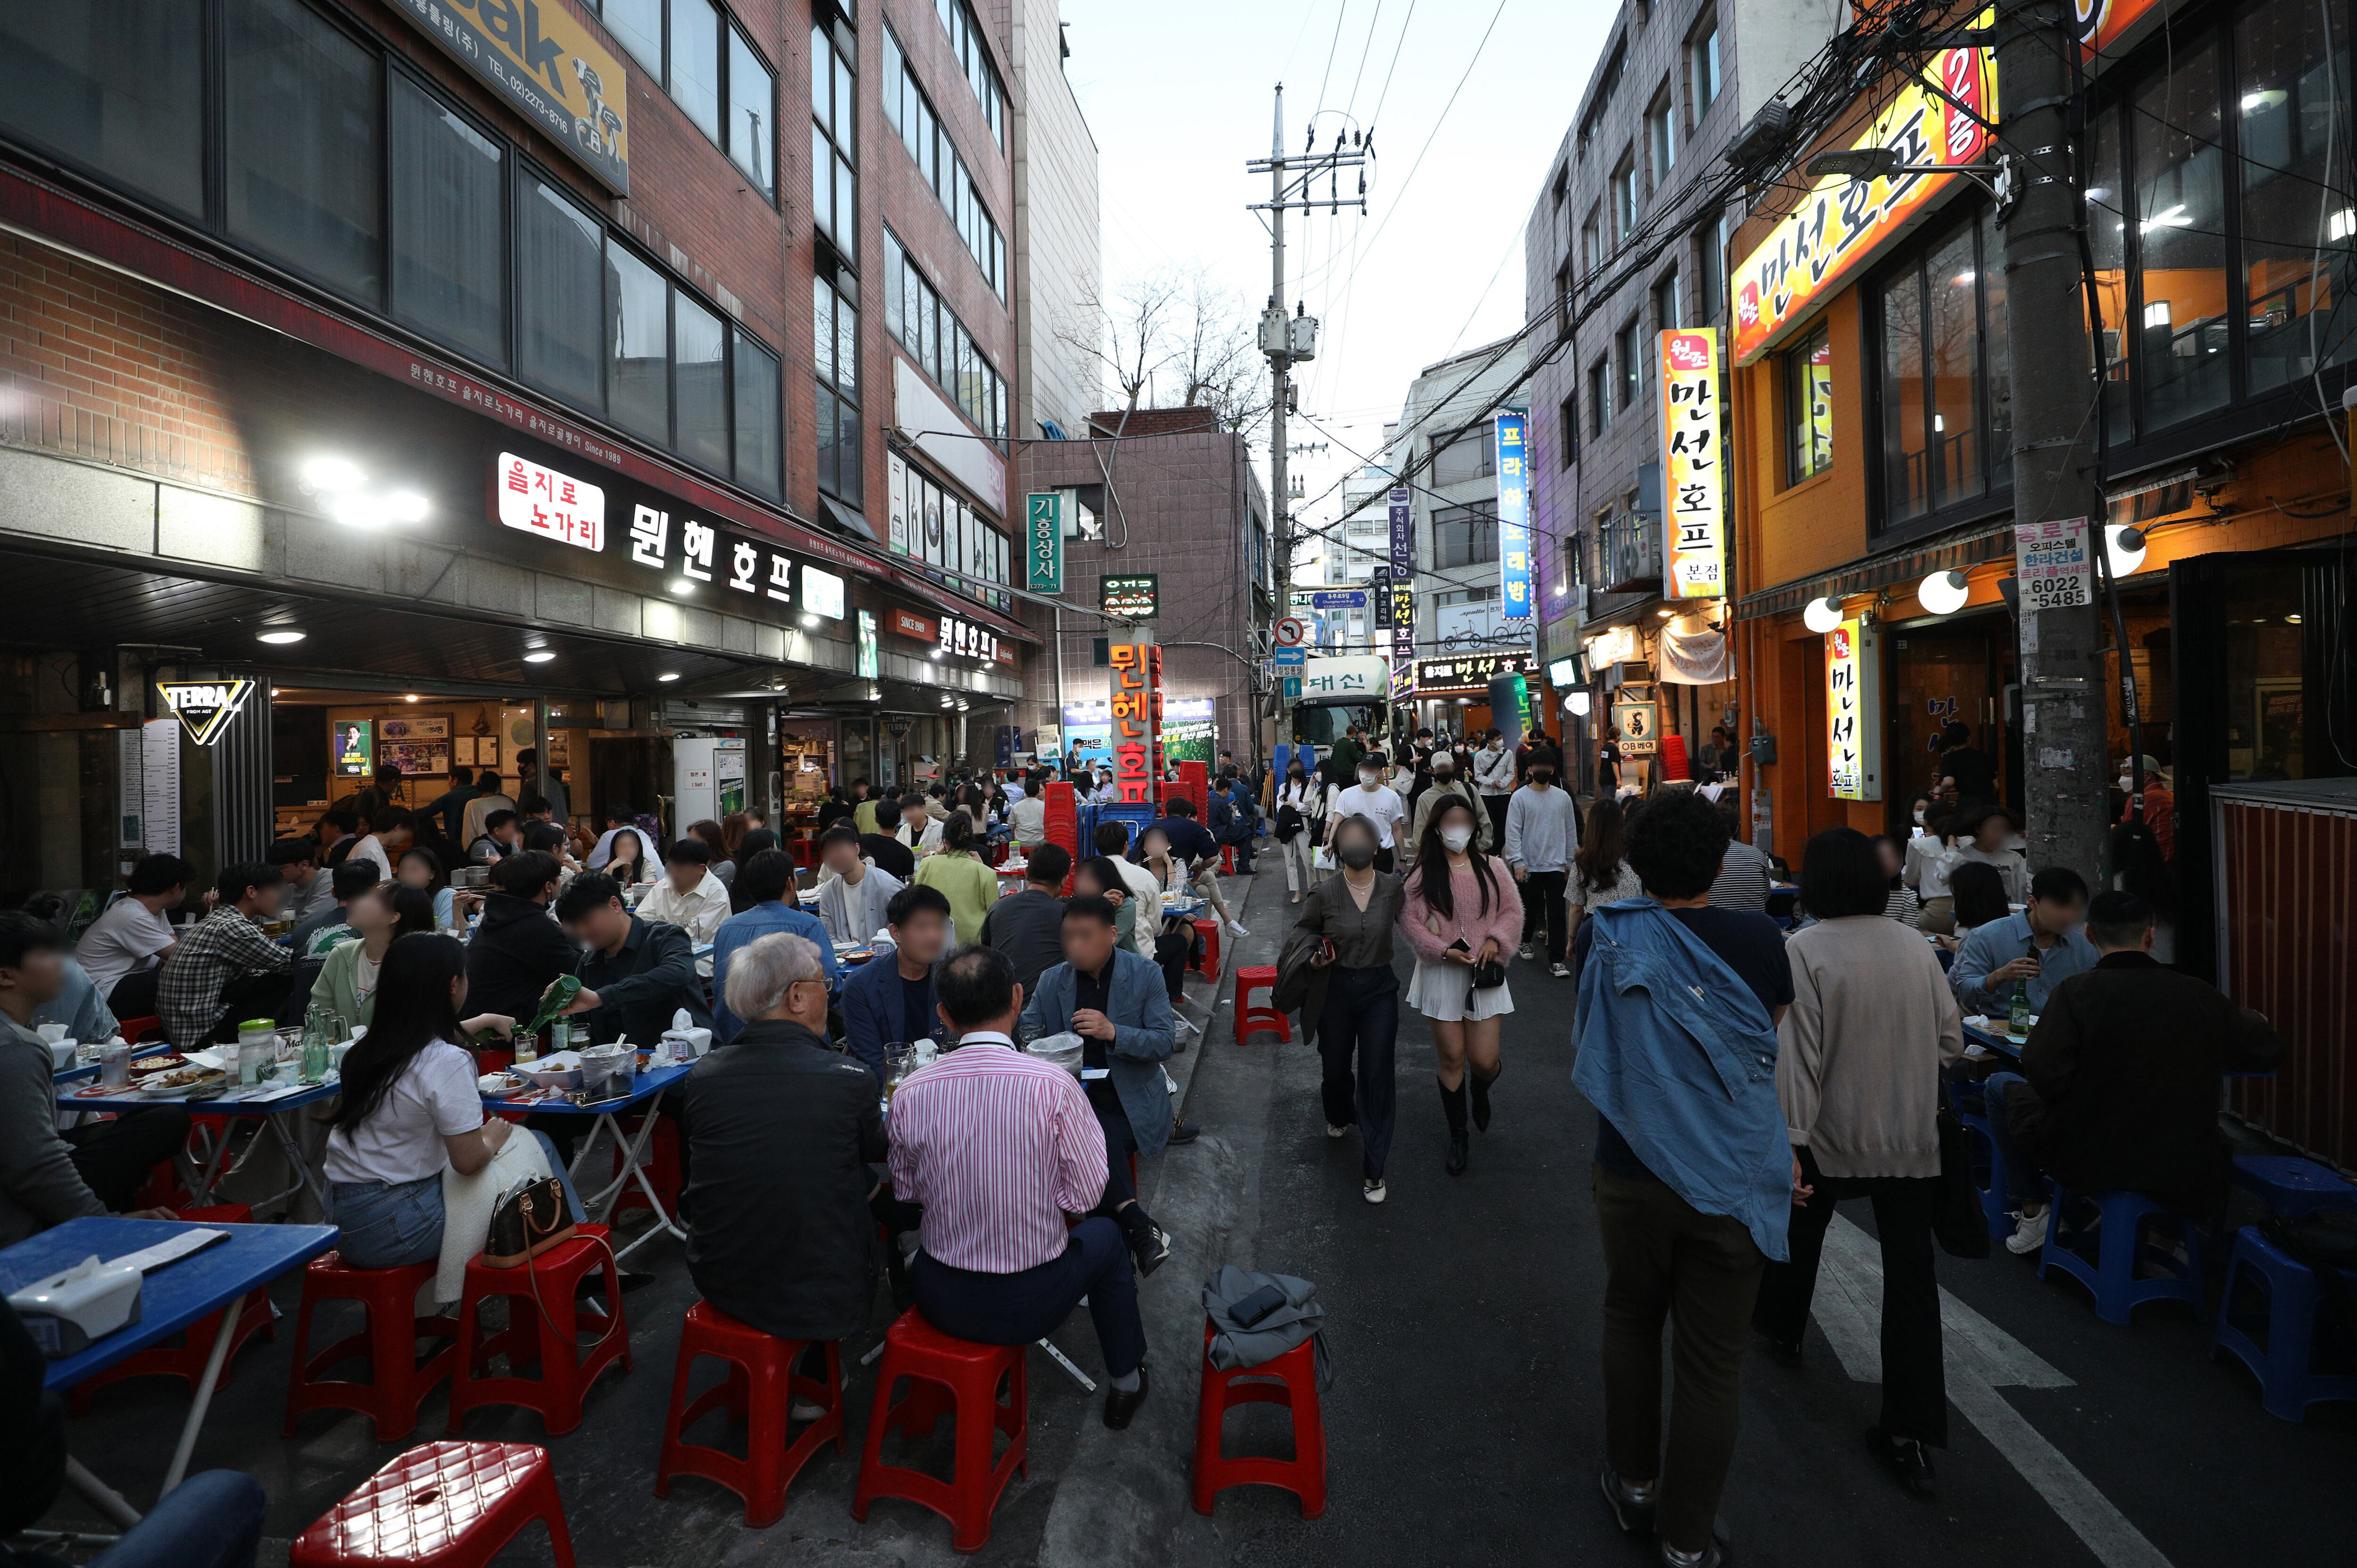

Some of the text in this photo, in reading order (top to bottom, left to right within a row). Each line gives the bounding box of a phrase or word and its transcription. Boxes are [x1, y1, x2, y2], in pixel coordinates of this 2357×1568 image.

[454, 0, 567, 100] ak
[409, 0, 568, 134] 용툴링(주) TEL. 02)2273-8716
[1761, 107, 1937, 316] 만선호프
[1670, 339, 1708, 368] 원조
[410, 363, 621, 464] 뮌헨호프 을지로노가리 을지로골뱅이 Since 1989
[1671, 379, 1714, 551] 만선호프
[508, 460, 578, 505] 을지로
[531, 504, 596, 548] 노가리
[1034, 499, 1056, 579] 기흥상사
[1395, 508, 1405, 541] 주식회사
[2017, 518, 2088, 543] 종로구
[630, 503, 791, 603] 뮌헨호프
[2024, 548, 2084, 567] 한라건설
[2030, 538, 2076, 552] 오피스텔
[1686, 564, 1718, 581] 본점
[2032, 576, 2079, 594] 6022
[901, 616, 925, 633] SINCE 1989
[1834, 633, 1849, 656] 원조
[1278, 666, 1302, 675] 일방통행
[1309, 674, 1365, 691] 대신
[166, 686, 231, 712] TERRA
[1110, 644, 1148, 803] 뮌헨호프
[1831, 768, 1854, 792] 호프
